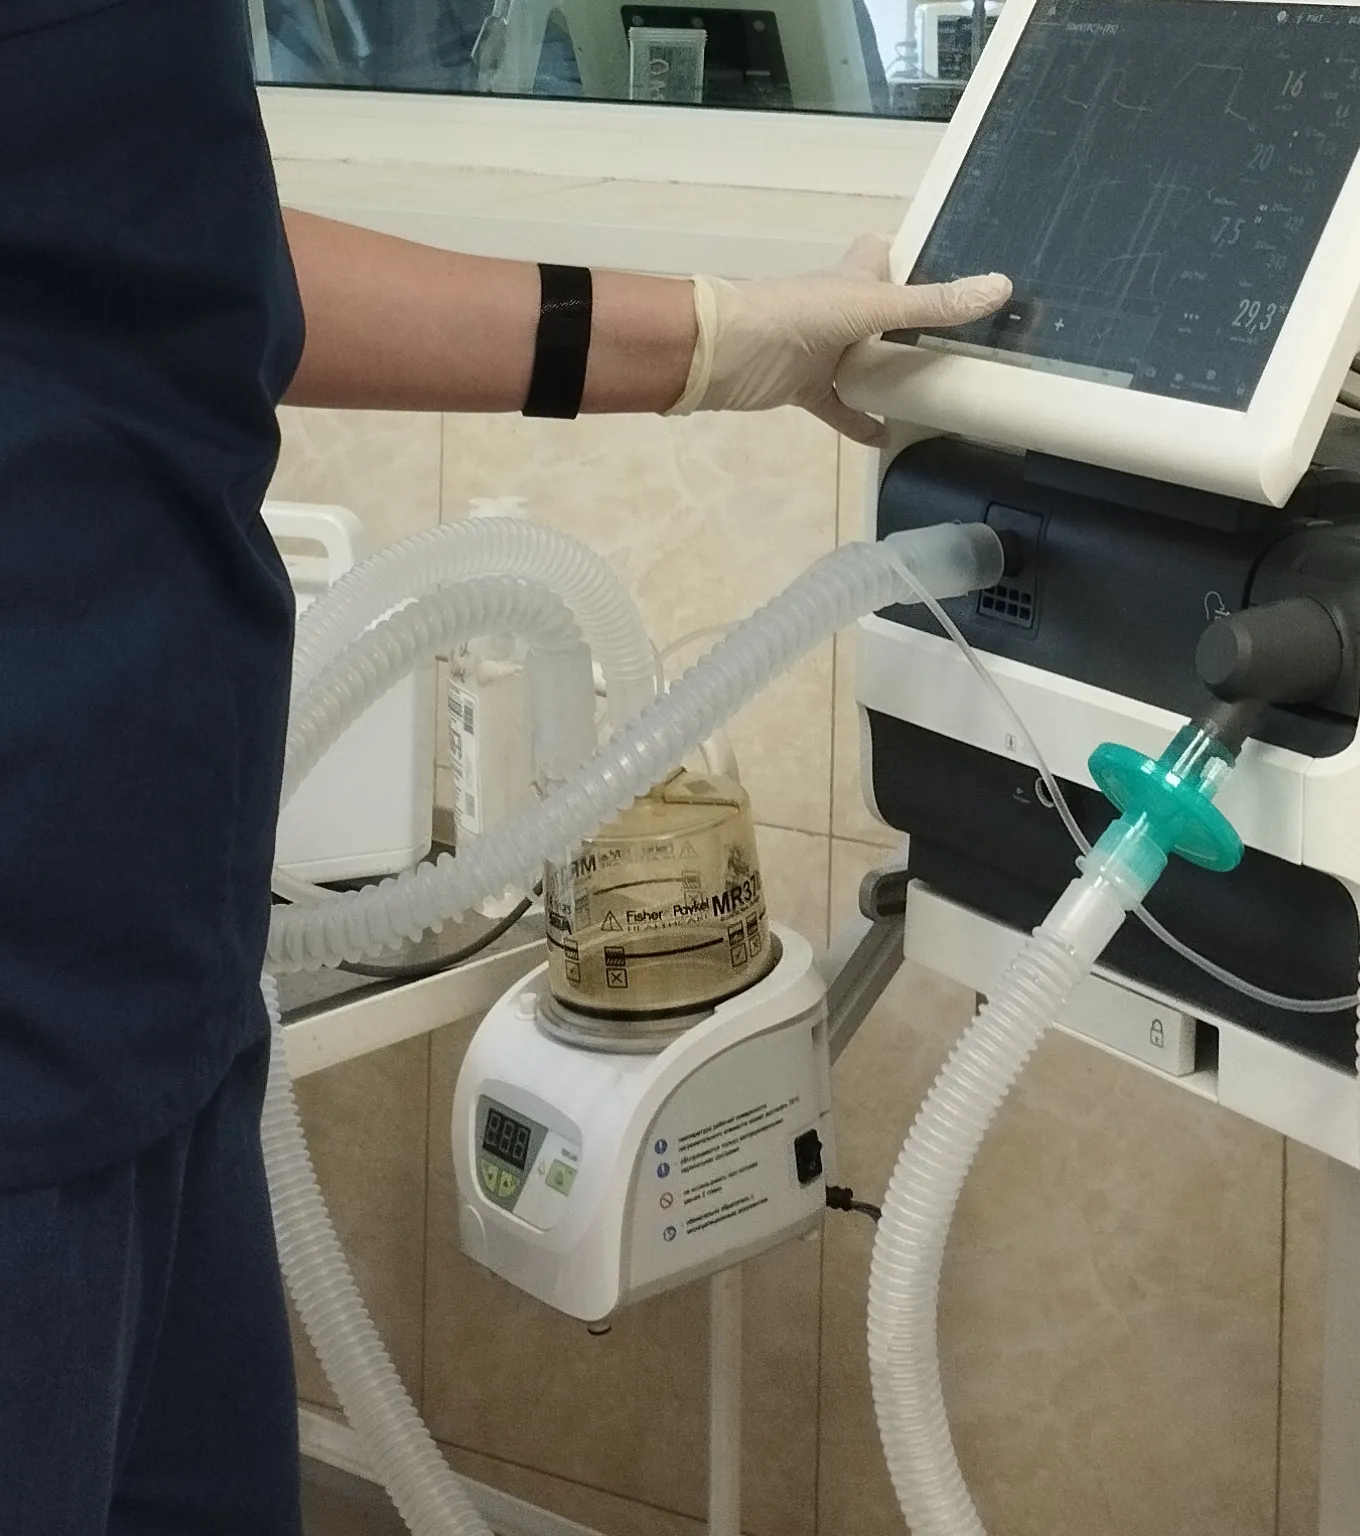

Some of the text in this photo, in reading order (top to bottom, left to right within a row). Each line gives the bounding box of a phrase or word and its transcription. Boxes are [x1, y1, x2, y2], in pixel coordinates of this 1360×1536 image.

[1282, 70, 1308, 98] 16
[1231, 298, 1277, 335] 29,3
[626, 909, 664, 923] Fisher
[673, 897, 709, 917] Paykel
